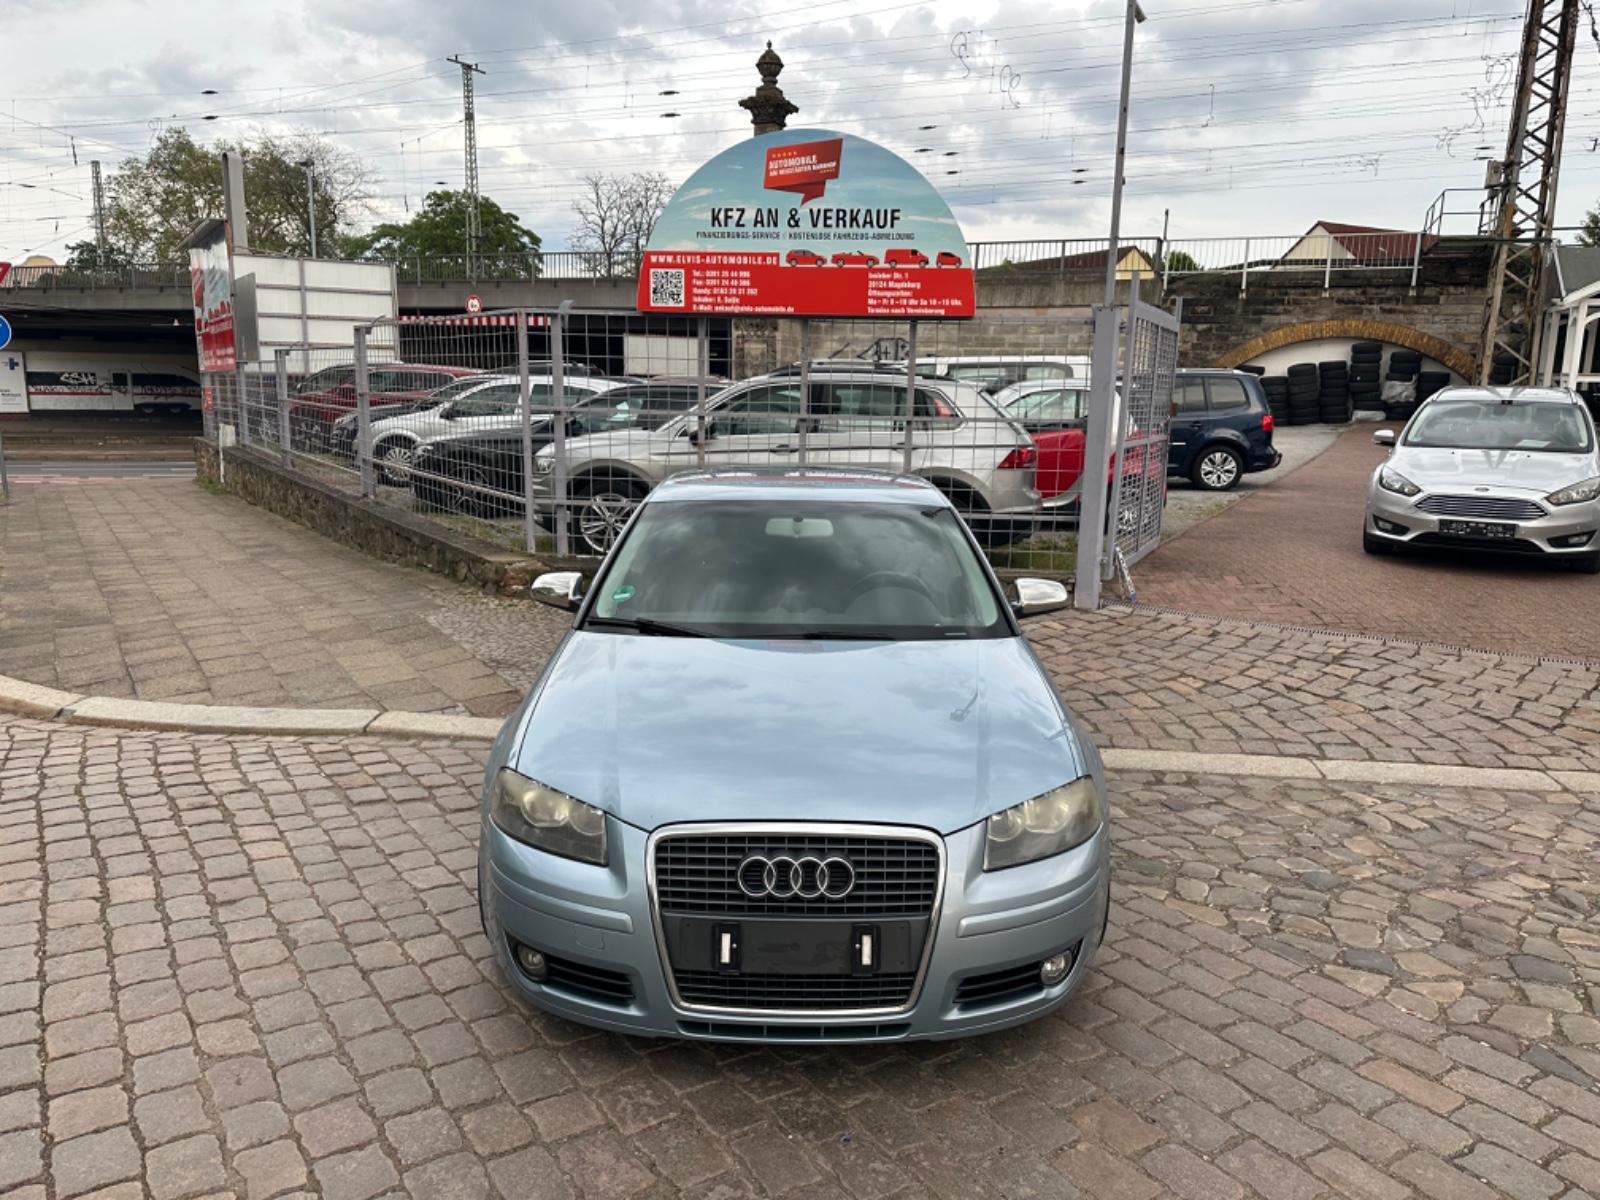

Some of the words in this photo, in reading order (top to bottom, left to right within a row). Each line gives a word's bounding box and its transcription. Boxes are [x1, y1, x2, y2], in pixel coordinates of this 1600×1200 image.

[769, 155, 817, 169] AUTOMOBILE
[711, 208, 745, 228] KFZ
[753, 208, 778, 228] AN
[787, 208, 800, 228] &
[809, 209, 901, 228] VERKAUF
[696, 231, 780, 239] FINANZIERUNGS-SERVICE
[788, 232, 831, 240] KOSTENLOSE
[833, 232, 915, 241] FAHRZEUG-ABMELDUNG
[650, 255, 777, 265] WWW.ELVIS-AUTOMOBILE.DE
[888, 281, 921, 289] Magdeburg
